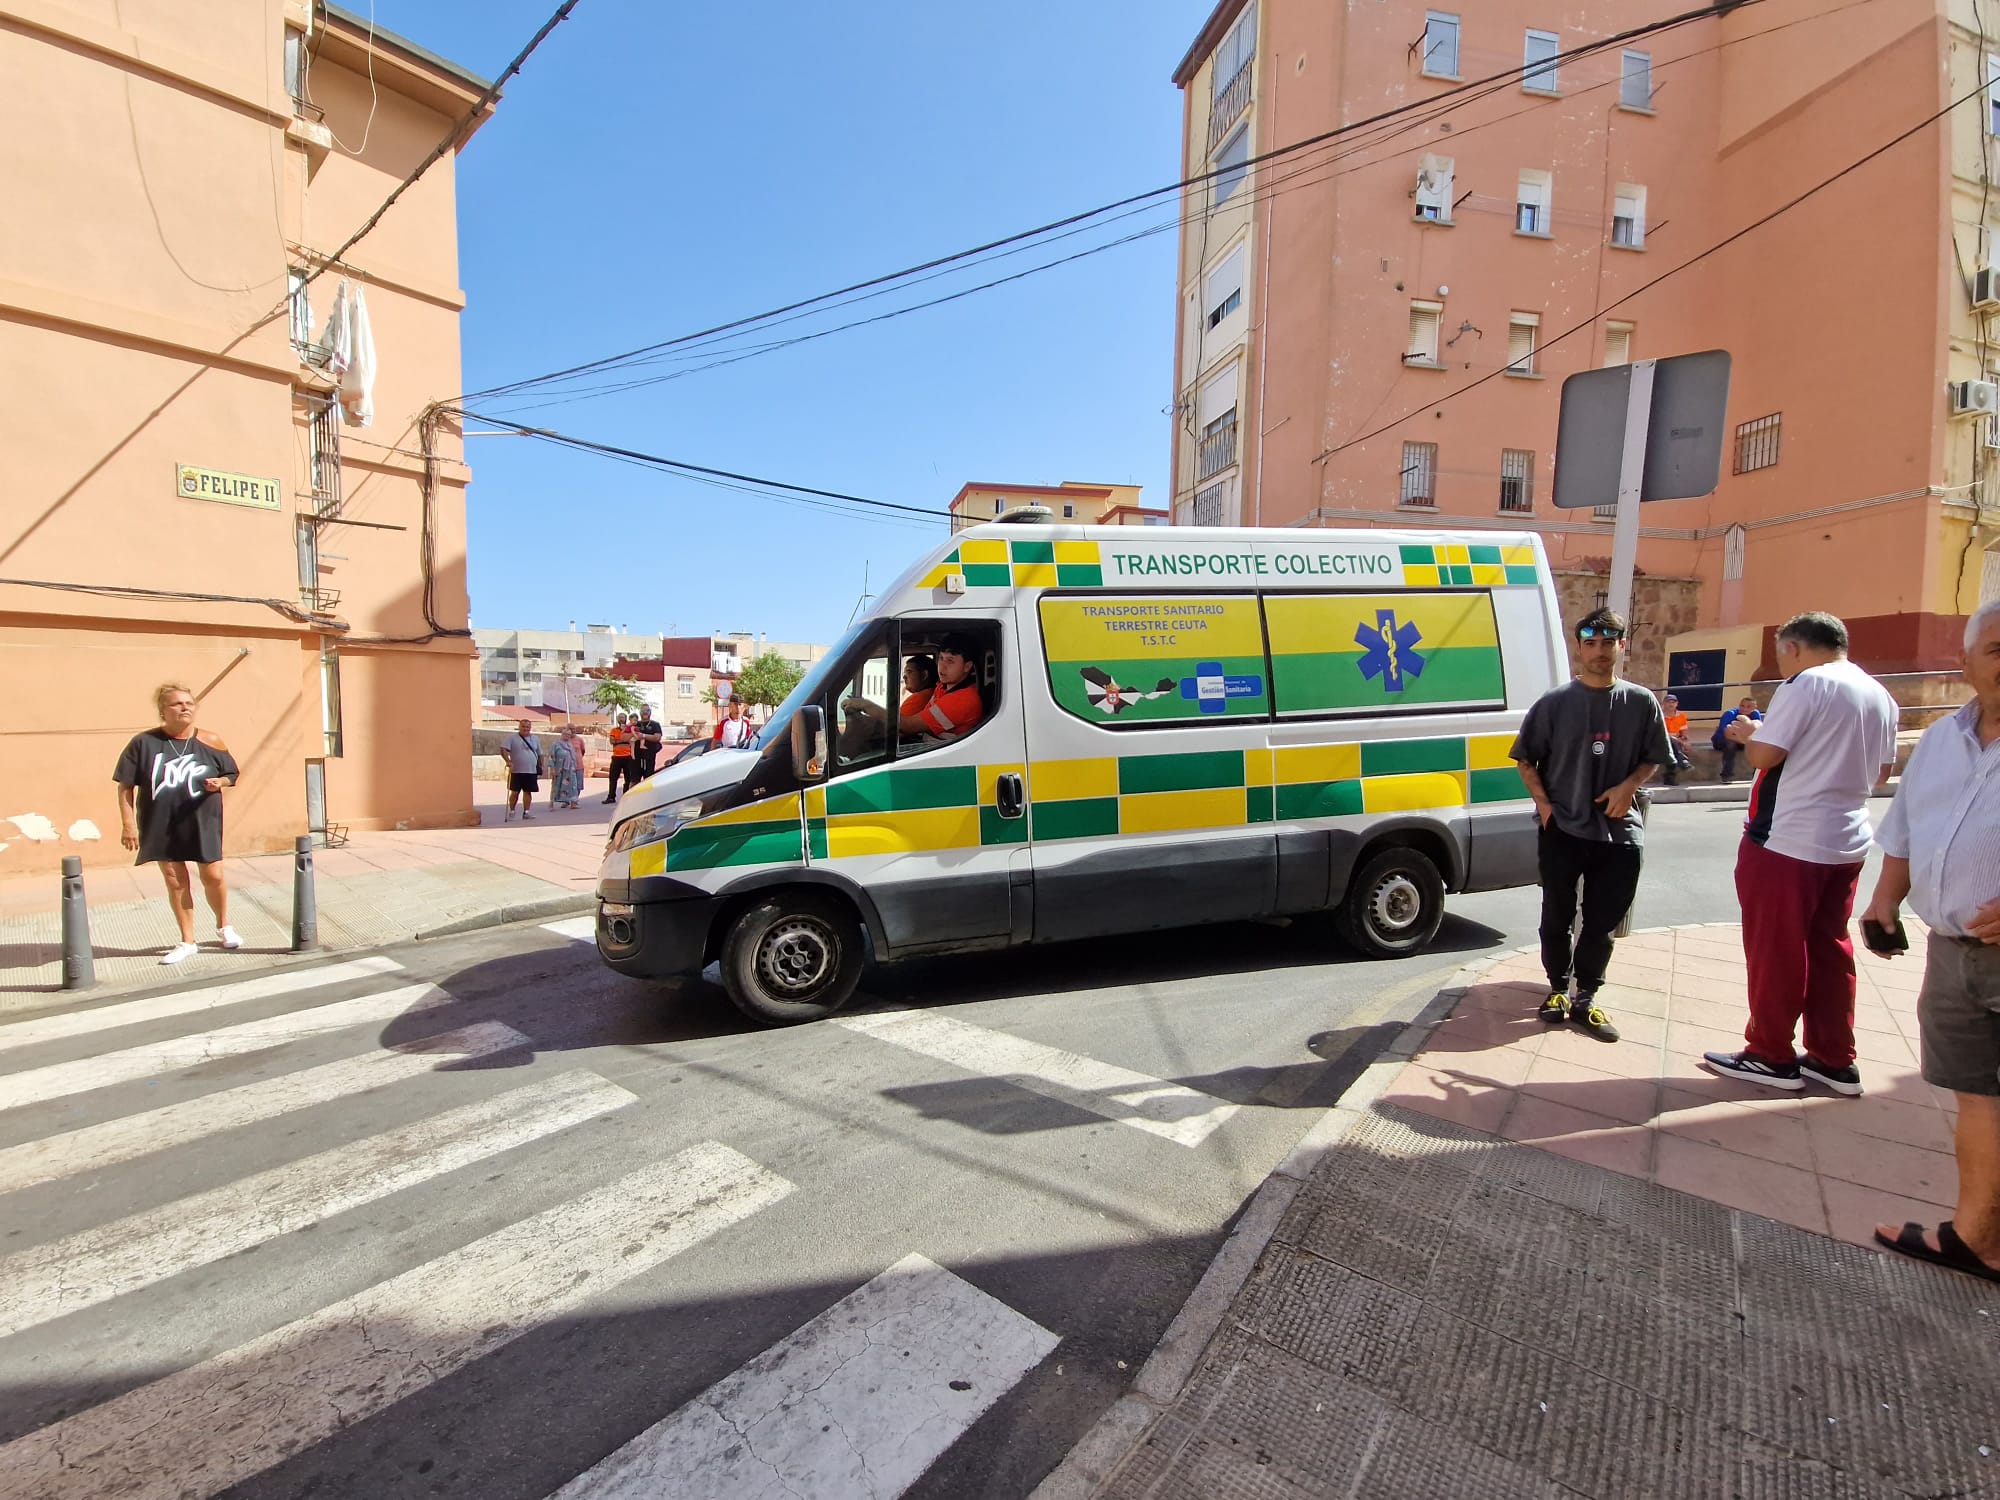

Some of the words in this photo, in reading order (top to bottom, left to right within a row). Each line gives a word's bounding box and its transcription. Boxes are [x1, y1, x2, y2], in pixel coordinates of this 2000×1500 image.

[200, 474, 260, 500] FELIPE
[264, 484, 276, 503] II
[1112, 554, 1269, 575] TRANSPORTE
[1274, 554, 1393, 575] COLECTIVO
[1081, 606, 1160, 617] TRANSPORTE
[1163, 605, 1225, 616] SANITARIO
[1104, 620, 1169, 632] TERRESTRE
[1171, 619, 1208, 631] CEUTA
[1140, 634, 1177, 646] T.S.T.C
[1225, 684, 1252, 693] Sanitaria
